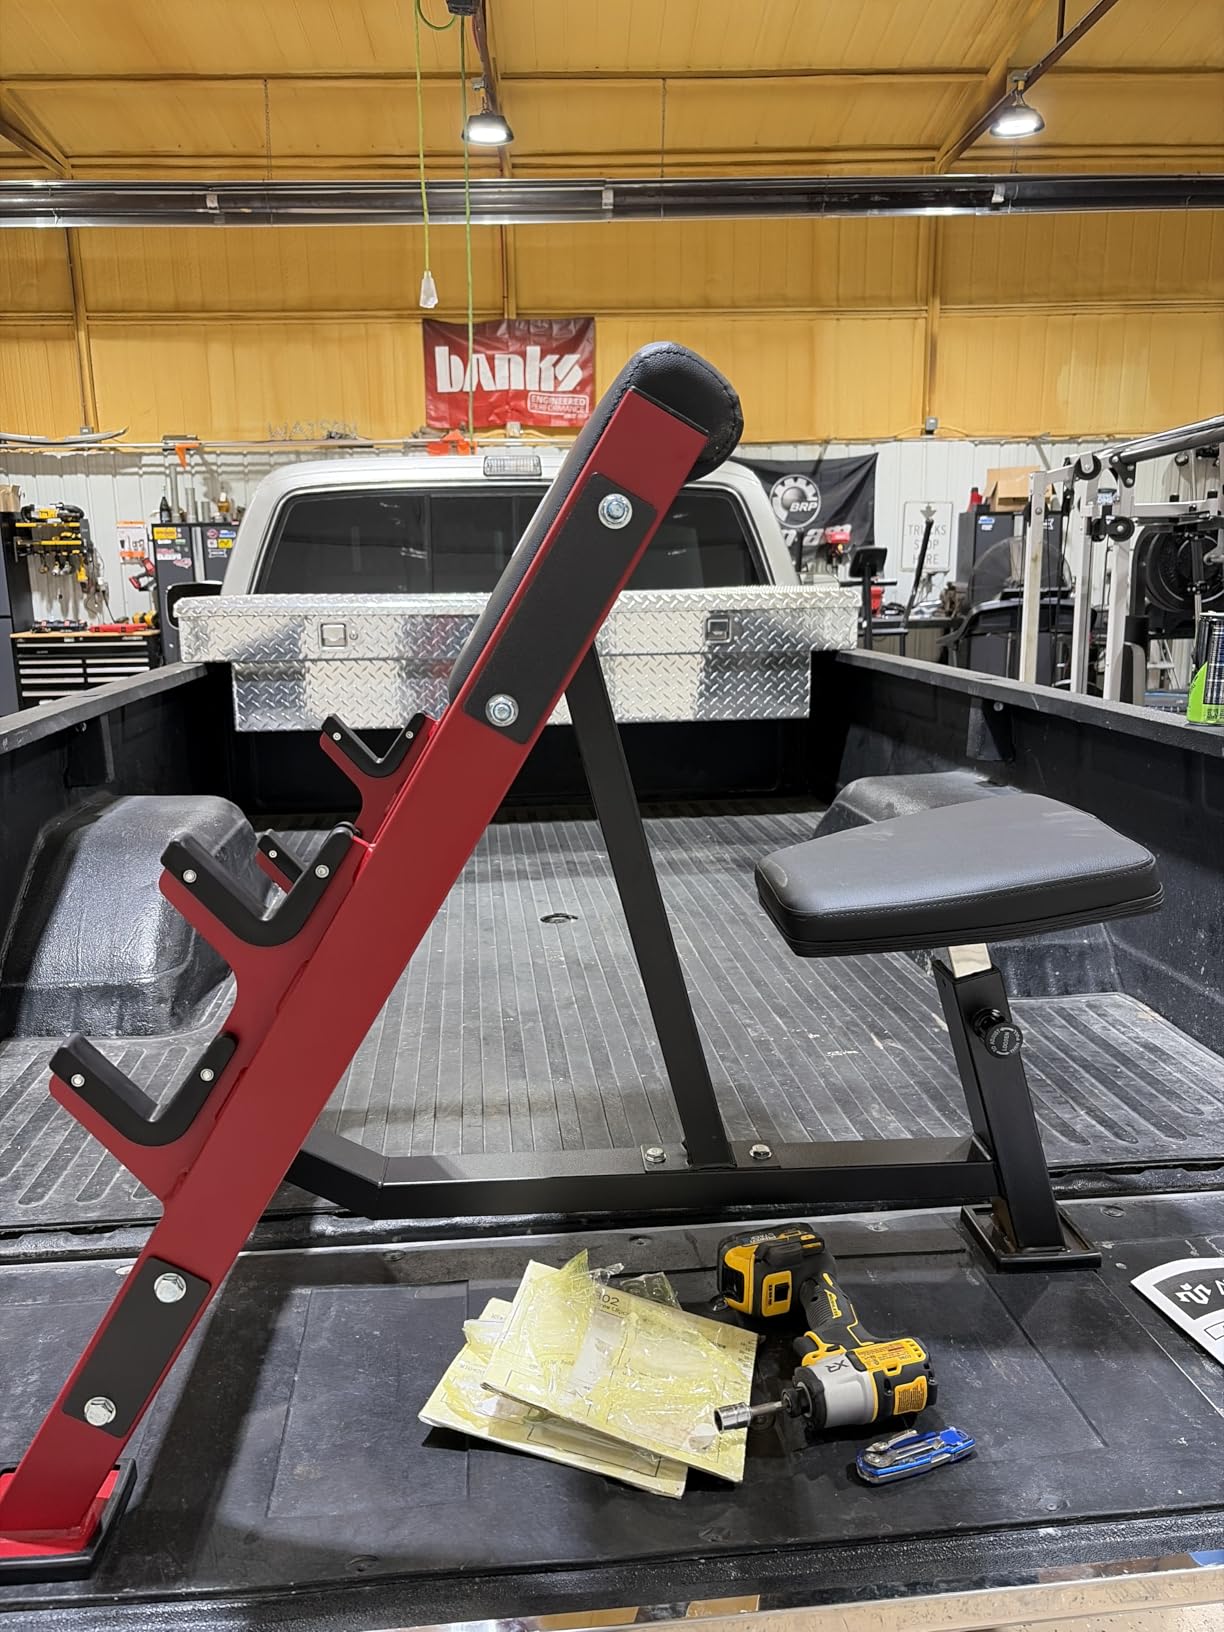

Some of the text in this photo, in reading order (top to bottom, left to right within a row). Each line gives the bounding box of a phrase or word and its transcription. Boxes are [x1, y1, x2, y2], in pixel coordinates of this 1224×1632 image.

[434, 345, 583, 393] banks
[789, 501, 818, 512] BRP
[908, 524, 946, 535] TRKS
[913, 539, 939, 550] SOP
[912, 554, 939, 565] HRE
[1001, 1031, 1010, 1051] LOOSEN
[824, 1359, 849, 1373] XR
